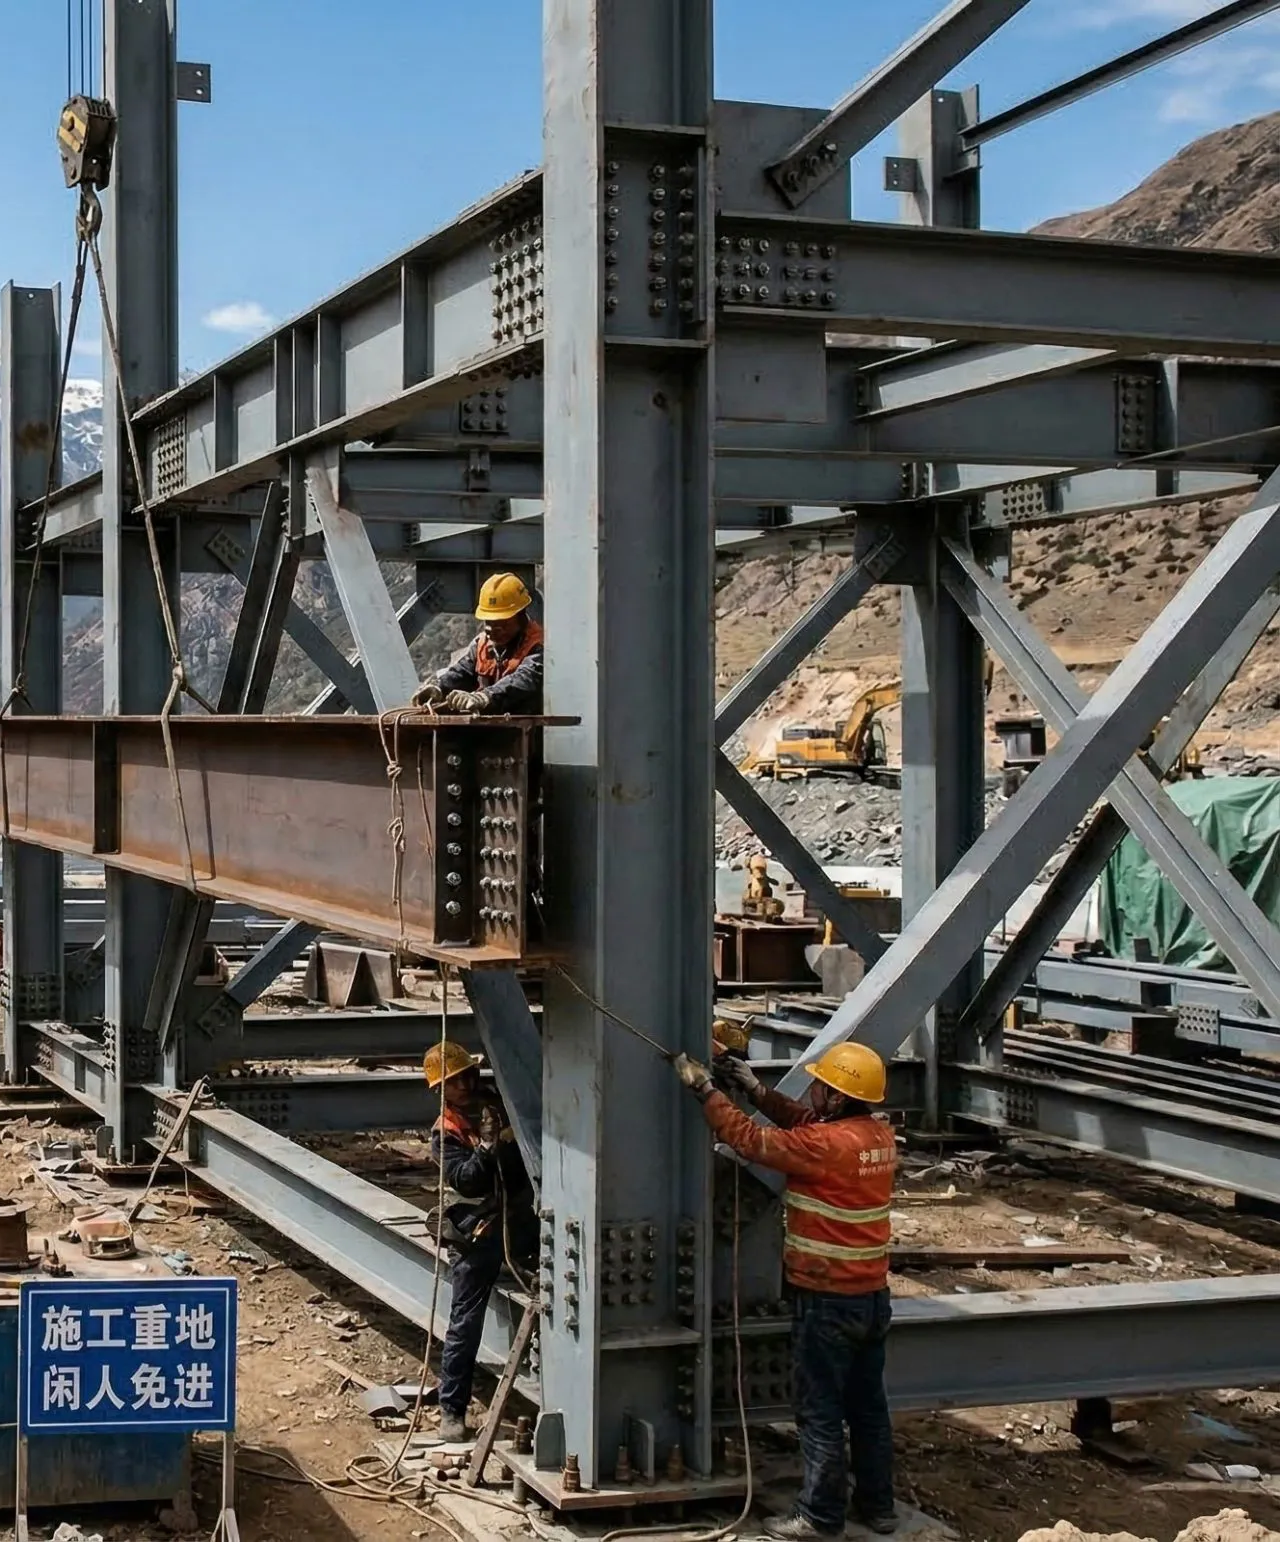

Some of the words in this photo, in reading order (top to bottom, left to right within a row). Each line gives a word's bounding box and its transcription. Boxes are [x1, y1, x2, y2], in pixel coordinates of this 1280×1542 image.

[41, 1303, 216, 1352] 施工重地
[42, 1362, 214, 1411] 闲人免进
